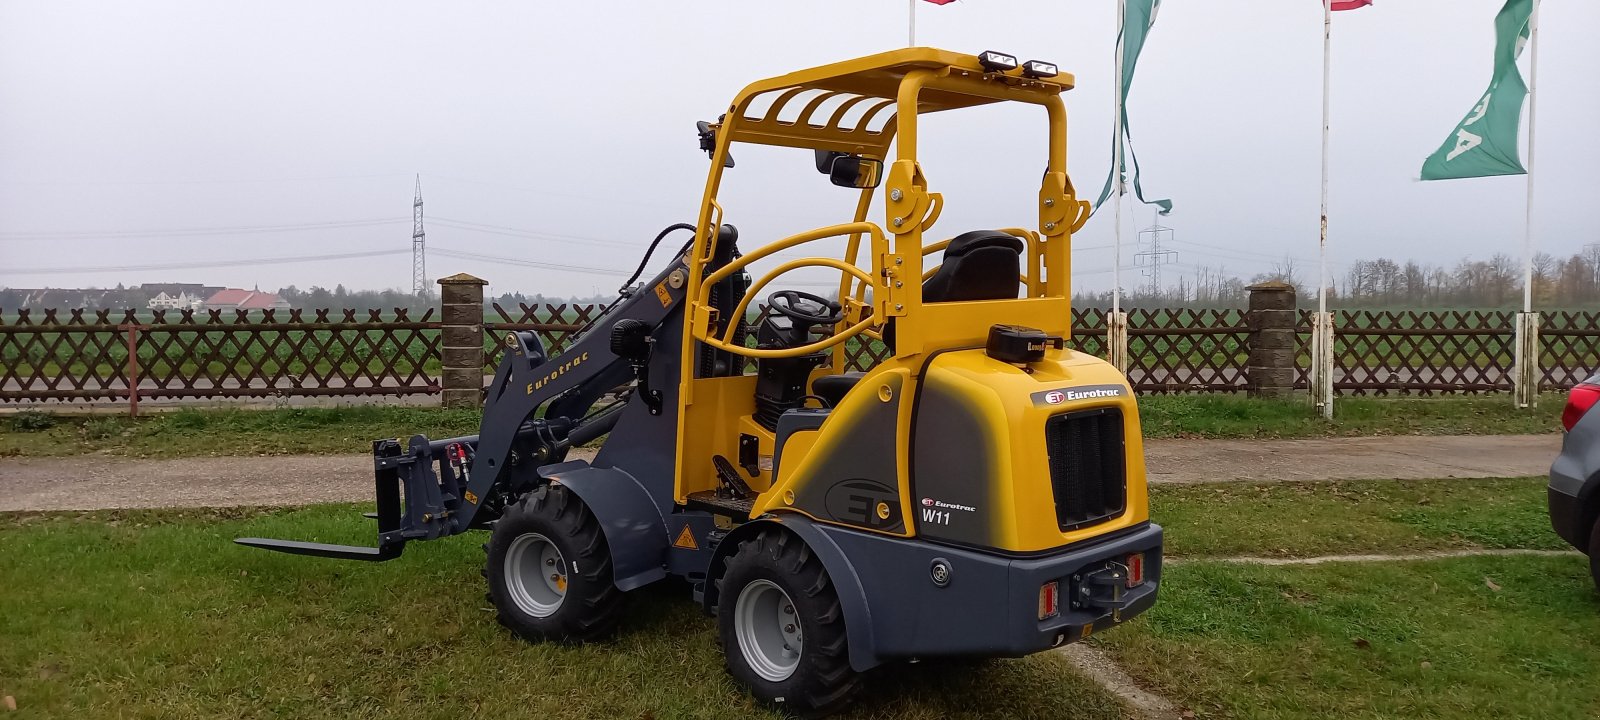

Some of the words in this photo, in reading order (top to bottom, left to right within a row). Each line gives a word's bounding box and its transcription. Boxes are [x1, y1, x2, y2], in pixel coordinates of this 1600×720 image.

[527, 352, 588, 394] Eurotrac
[1067, 389, 1119, 401] Eurotrac
[935, 500, 976, 512] Eurotrac
[922, 508, 950, 526] W11
